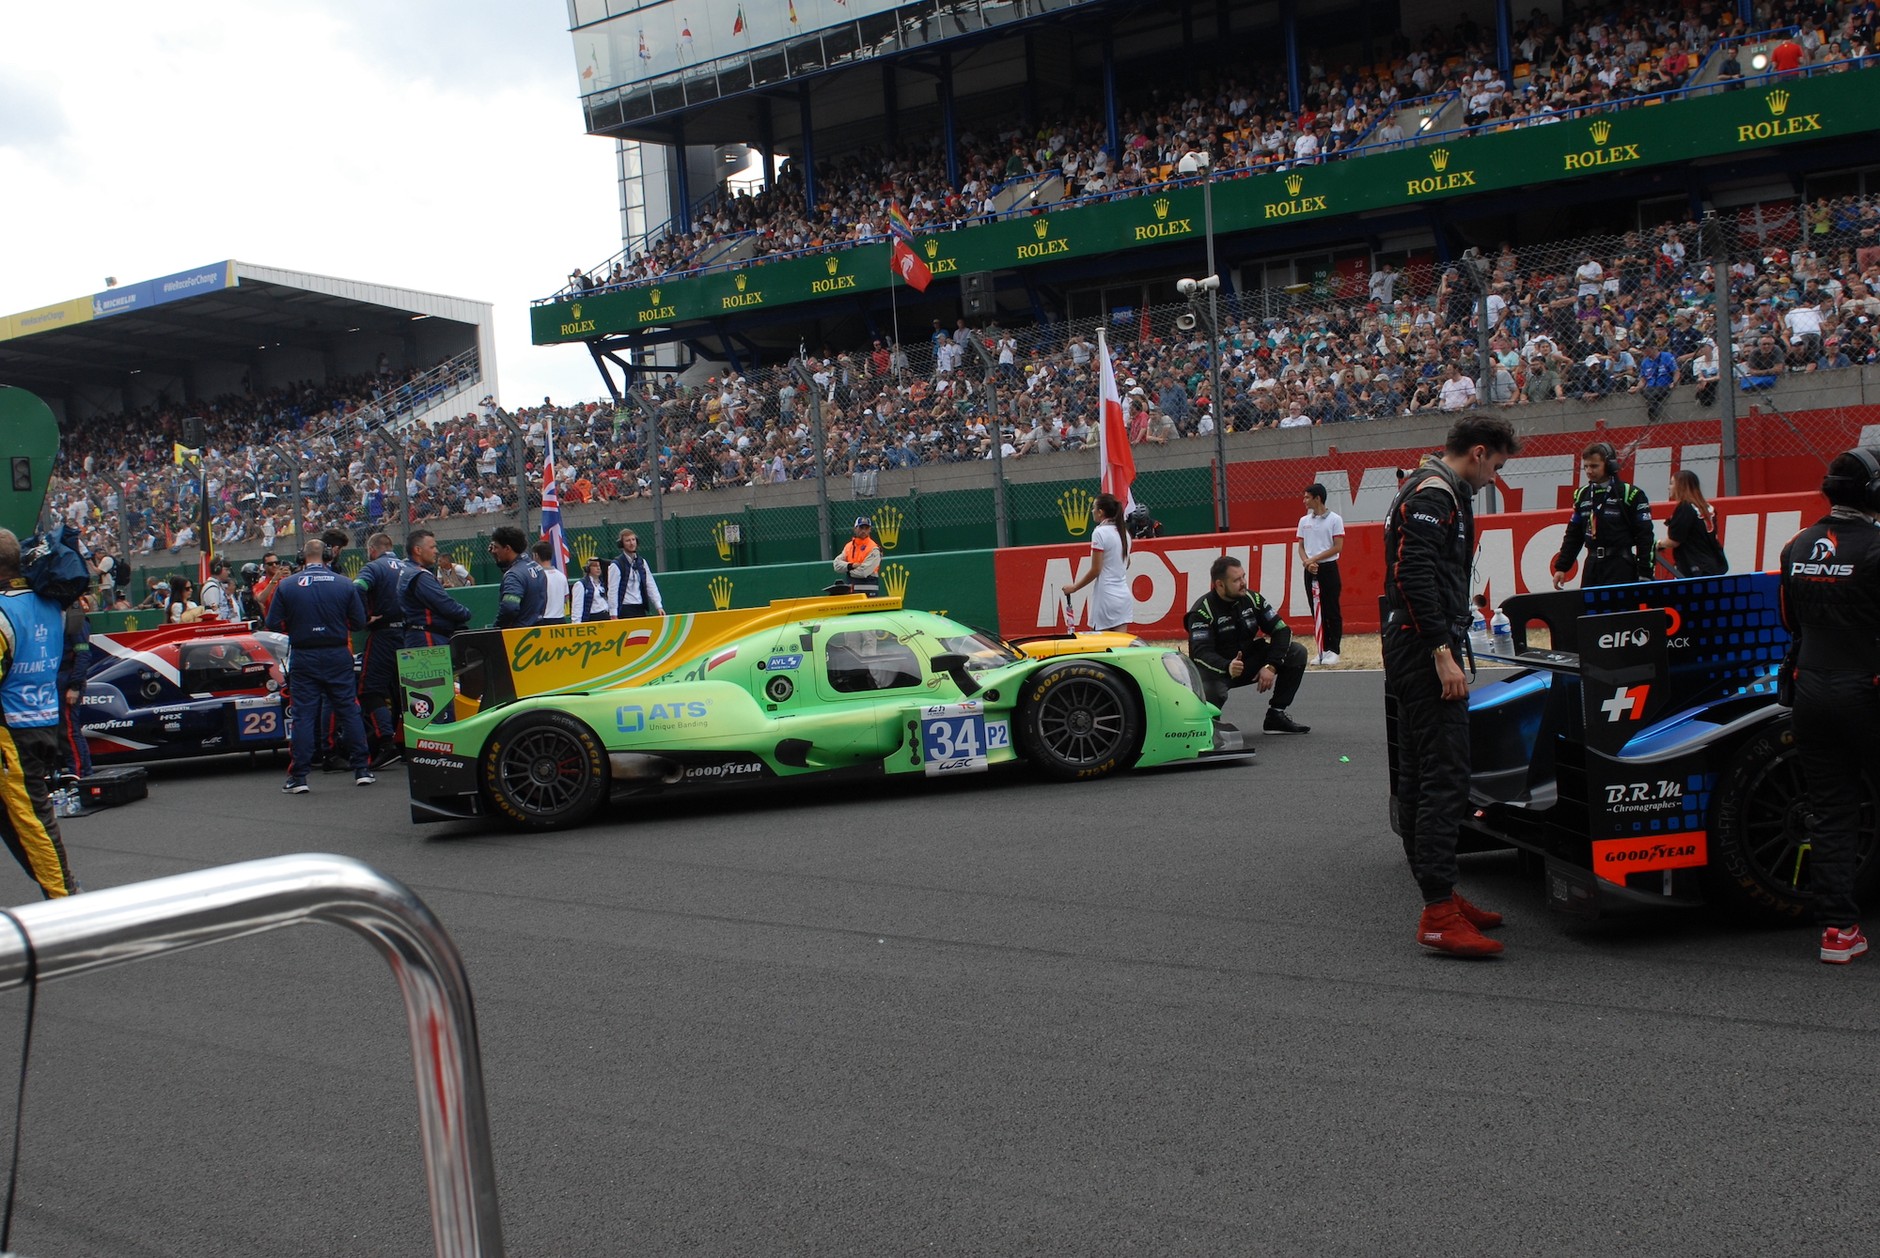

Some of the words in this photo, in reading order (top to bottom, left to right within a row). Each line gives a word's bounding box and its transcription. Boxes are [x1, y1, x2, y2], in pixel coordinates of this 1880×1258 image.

[1737, 113, 1822, 142] ROLEX
[1564, 143, 1640, 170] ROLEX
[1407, 169, 1477, 196] ROLEX
[1264, 195, 1327, 219] ROLEX
[1134, 218, 1192, 241] ROLEX
[1017, 238, 1069, 260] ROLEX
[923, 258, 957, 274] LEX
[163, 272, 218, 293] #WeRaceForChange
[811, 275, 856, 293] ROLEX
[103, 294, 137, 309] MICHELIN
[722, 291, 764, 309] ROLEX
[638, 305, 676, 323] ROLEX
[561, 319, 596, 336] ROLEX
[550, 625, 598, 639] INTER
[1598, 630, 1631, 649] elf
[511, 628, 628, 669] Europol
[1666, 637, 1690, 648] ACK
[415, 648, 446, 657] TENEG
[244, 665, 265, 673] MOTUL
[771, 658, 786, 666] AVL
[82, 695, 115, 705] RECT
[159, 712, 182, 721] HRX
[416, 711, 430, 719] PZM
[648, 701, 708, 720] ATS
[81, 719, 134, 731] GOODYEAR
[243, 711, 277, 735] 23
[649, 721, 676, 731] Unique
[677, 720, 709, 731] Banding
[928, 718, 980, 761] 34
[987, 725, 1008, 746] P2
[1164, 730, 1207, 739] GOODYEAR
[418, 740, 452, 752] MOTUL
[580, 731, 601, 778] EAGLE
[413, 756, 464, 769] GOODYEAR
[685, 762, 762, 778] GOODYEAR
[1604, 844, 1696, 863] GOODYEAR
